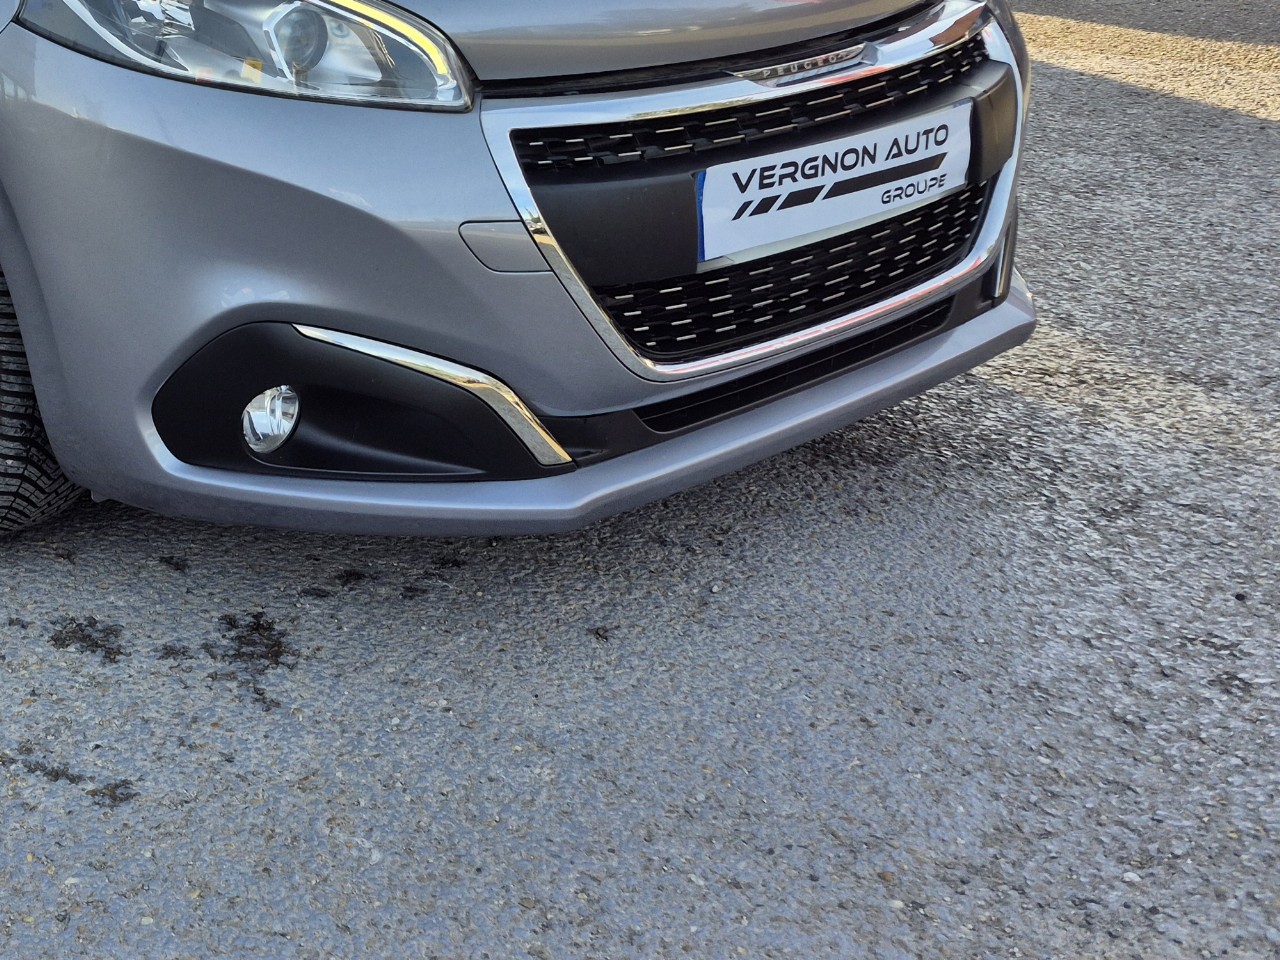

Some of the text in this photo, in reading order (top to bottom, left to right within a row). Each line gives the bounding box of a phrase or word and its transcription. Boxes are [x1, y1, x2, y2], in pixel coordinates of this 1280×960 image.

[763, 54, 849, 78] PEUGEOT
[731, 123, 950, 194] VERGNON AUTO
[881, 173, 947, 205] GROUPE
